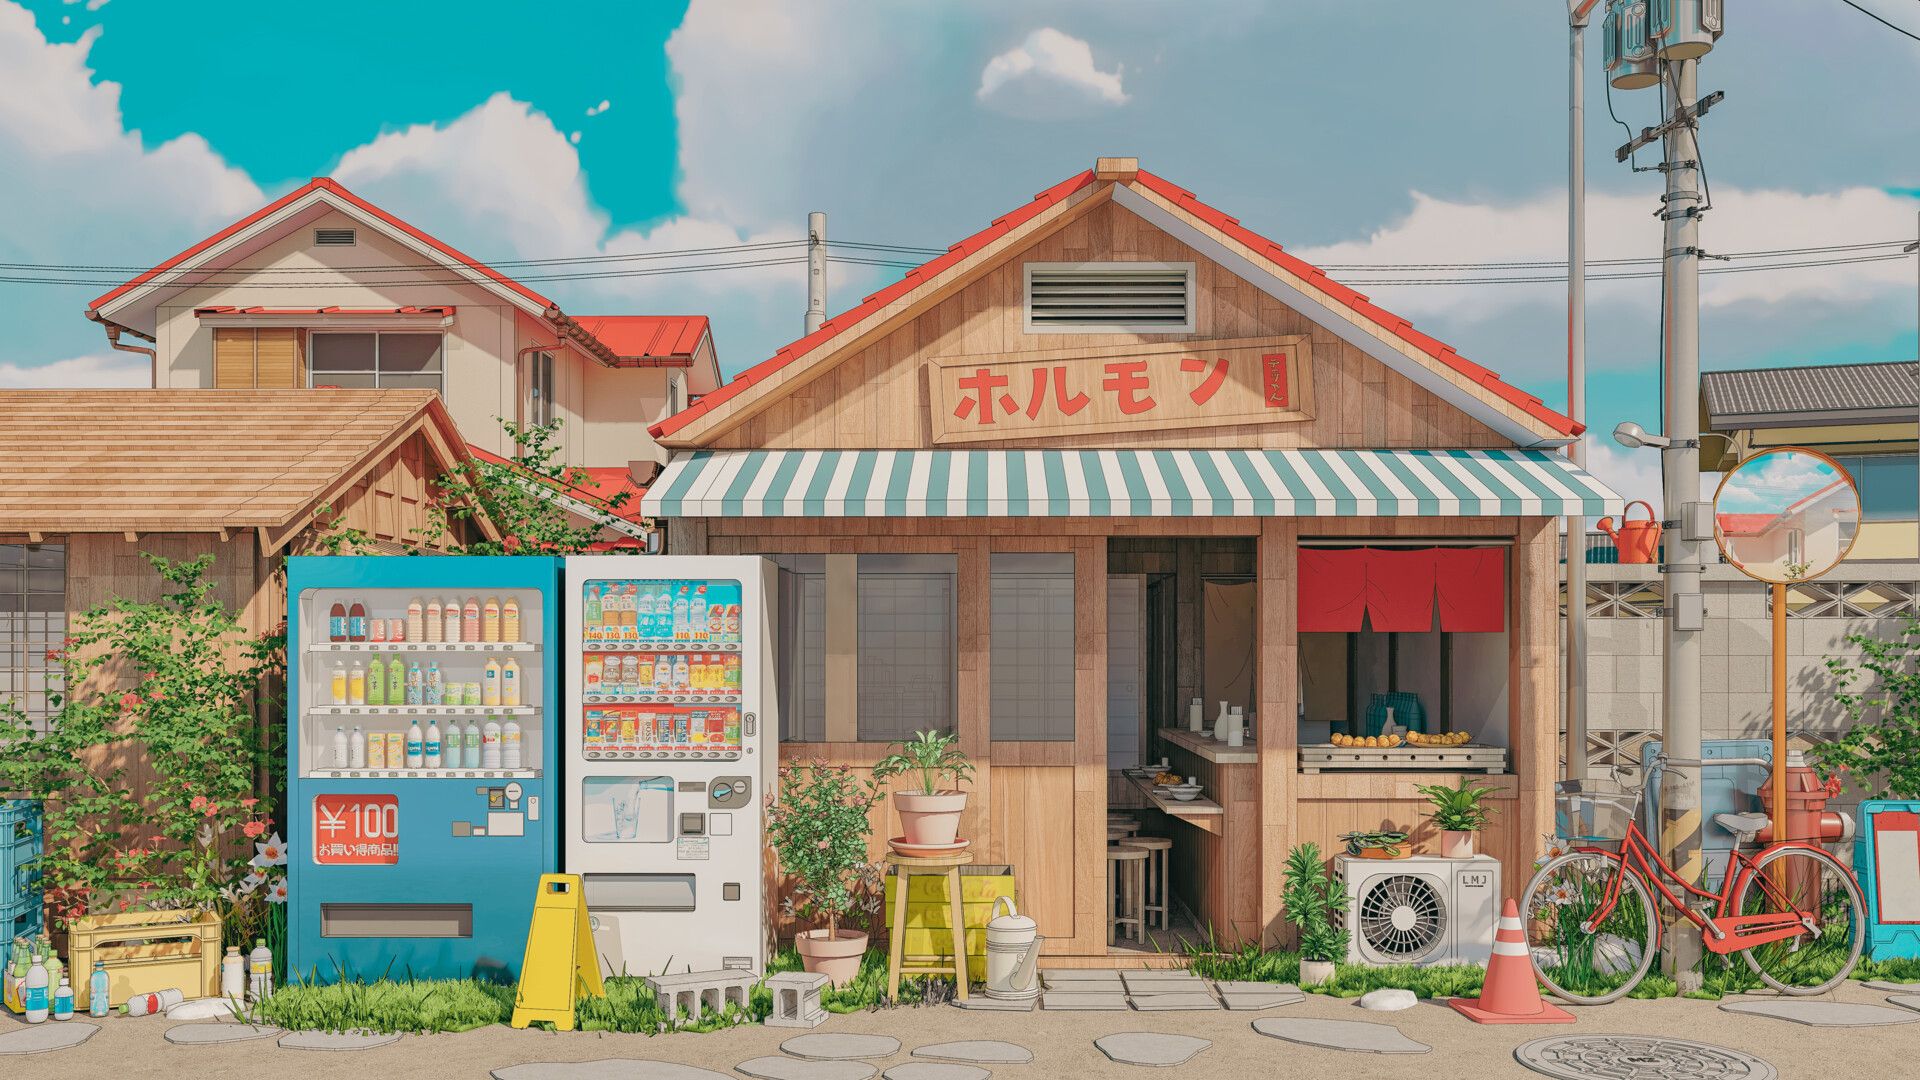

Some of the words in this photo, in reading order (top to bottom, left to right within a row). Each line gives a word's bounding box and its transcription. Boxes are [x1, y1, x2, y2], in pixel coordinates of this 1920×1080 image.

[954, 358, 1230, 425] ホルモン
[319, 803, 399, 838] ¥100
[1462, 875, 1487, 884] LMJ
